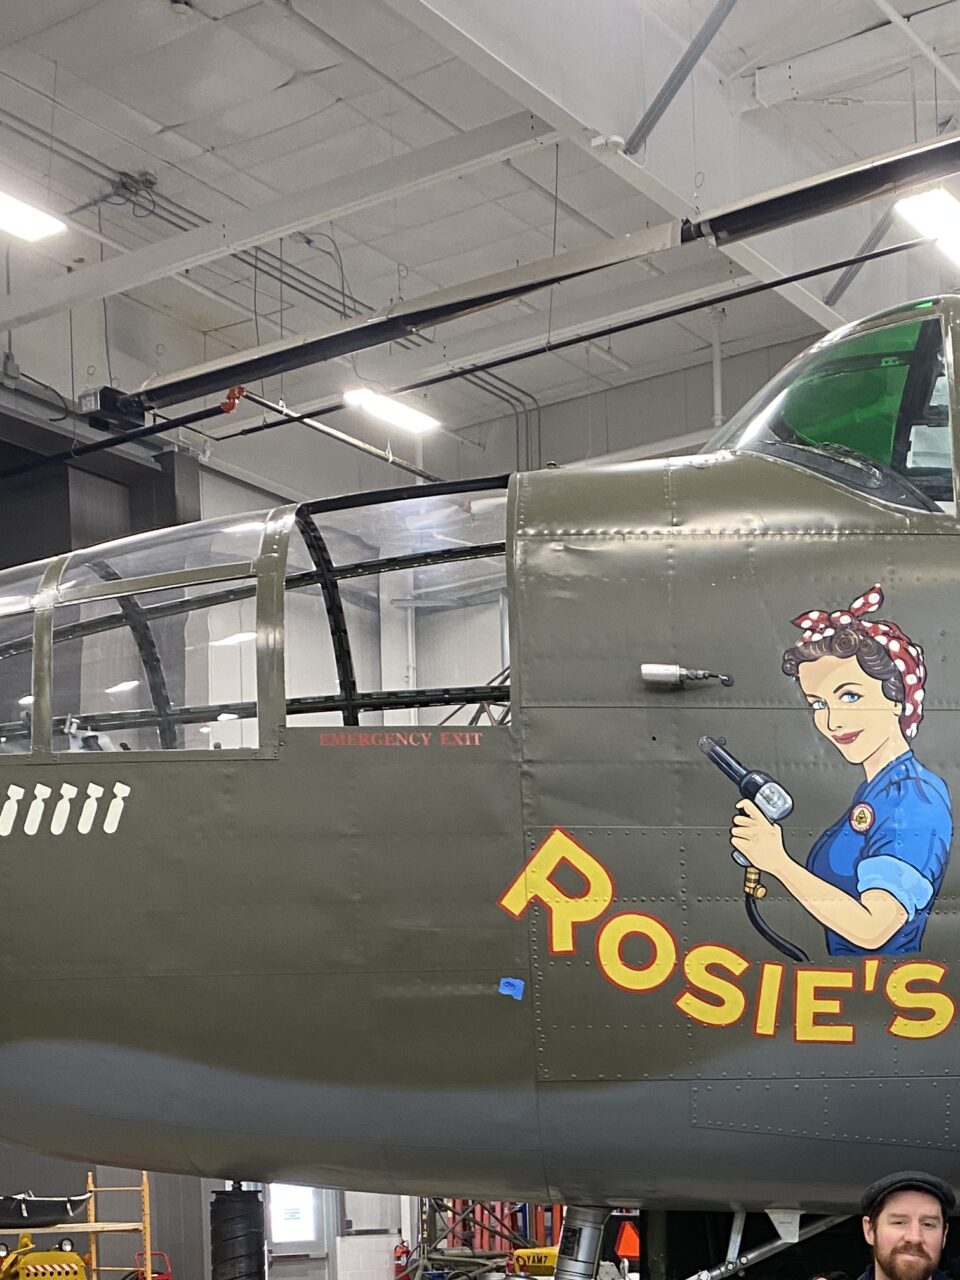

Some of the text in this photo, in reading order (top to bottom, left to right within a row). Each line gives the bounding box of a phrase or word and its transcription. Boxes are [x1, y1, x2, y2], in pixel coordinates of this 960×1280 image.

[319, 732, 483, 746] EMERGENCY EXIT
[497, 826, 957, 1044] ROSIE'S
[526, 1254, 548, 1265] YAM7
